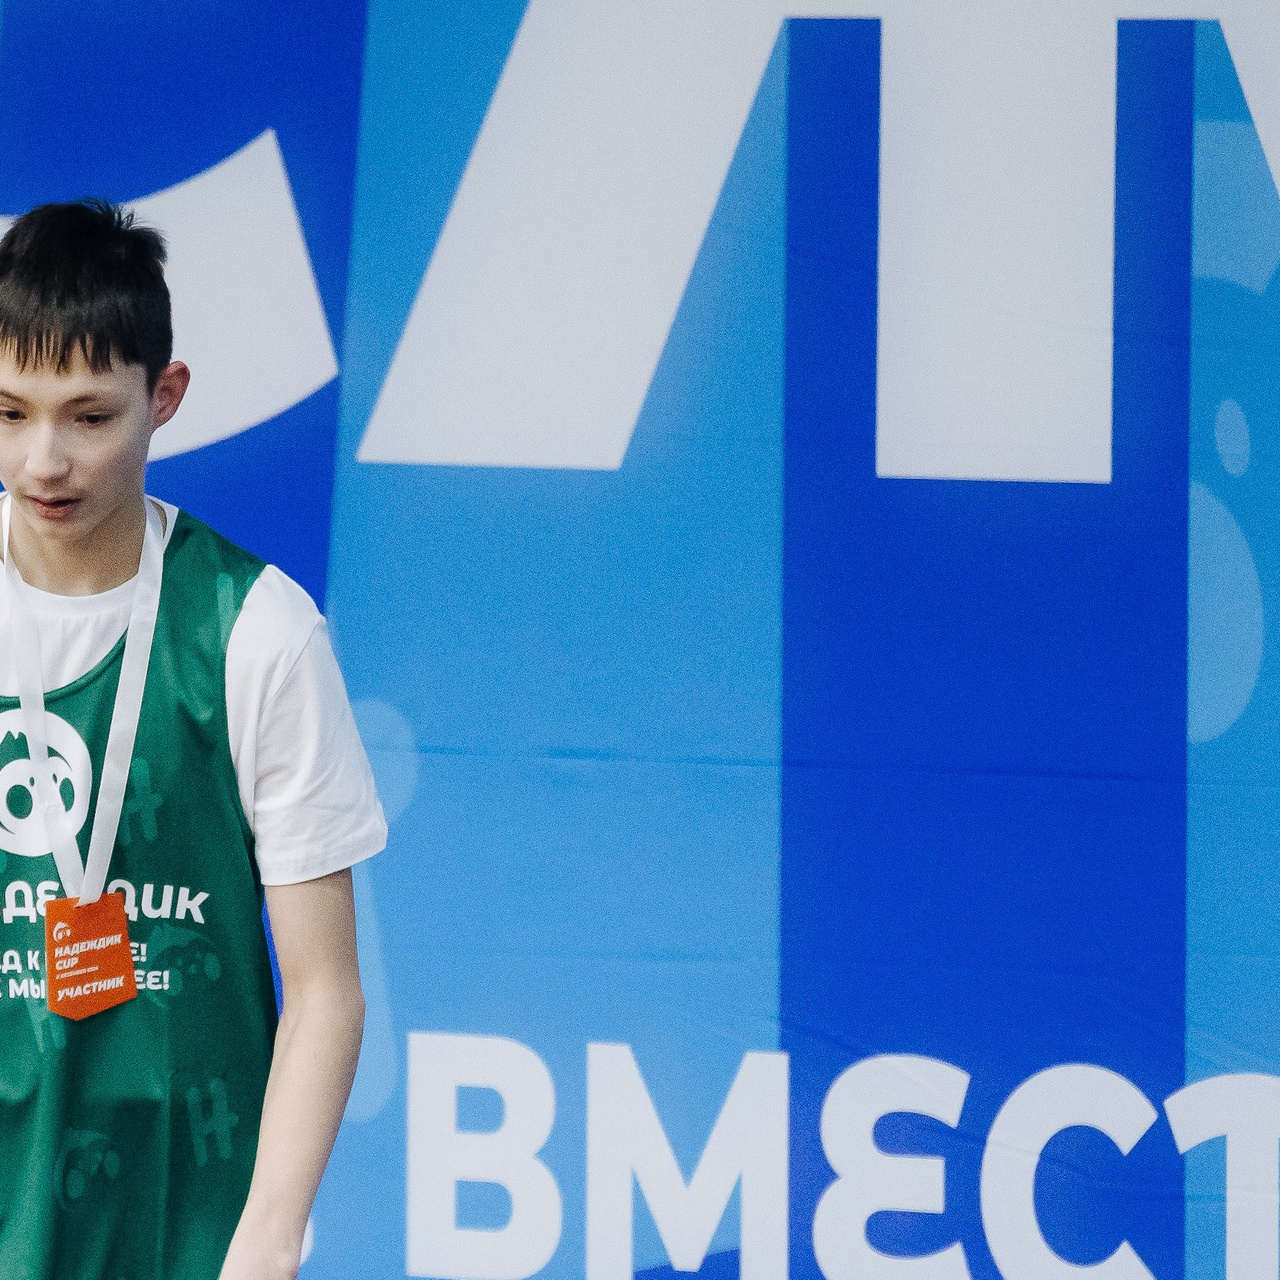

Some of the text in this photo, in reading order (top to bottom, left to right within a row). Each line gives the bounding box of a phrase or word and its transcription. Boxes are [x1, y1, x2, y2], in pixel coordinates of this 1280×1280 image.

[54, 933, 123, 958] НАДЕЖДИК
[27, 949, 40, 971] К
[57, 975, 125, 1002] УЧАСТНИК
